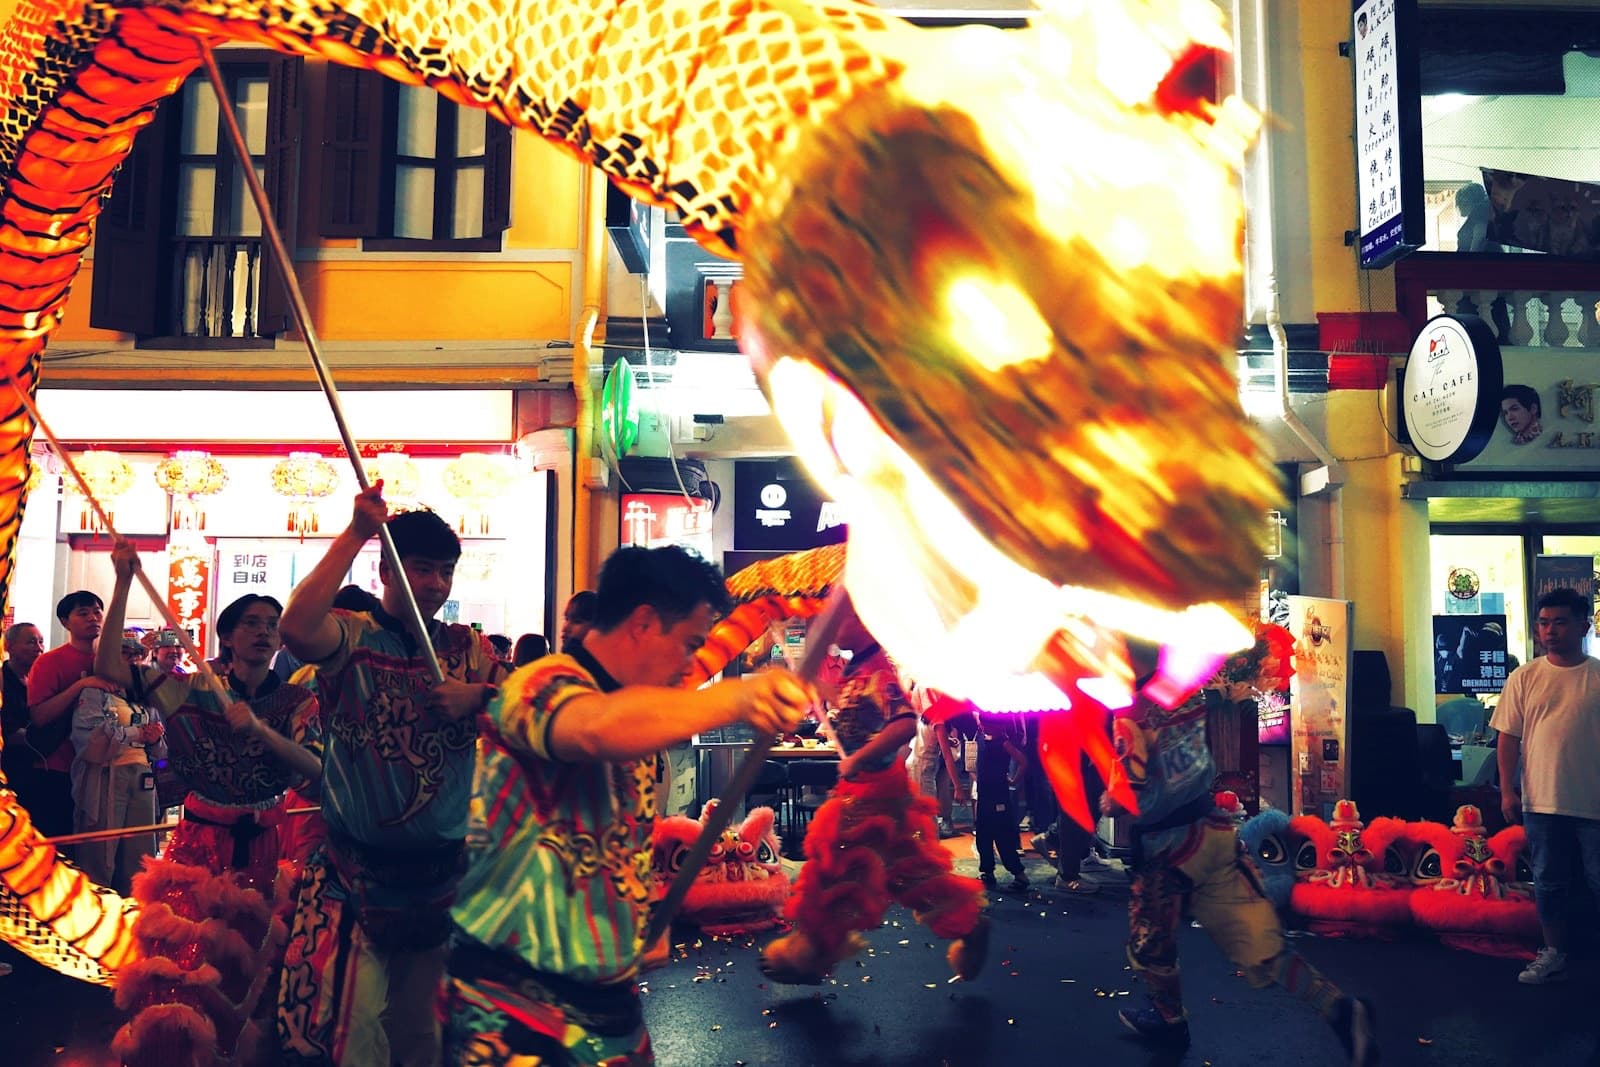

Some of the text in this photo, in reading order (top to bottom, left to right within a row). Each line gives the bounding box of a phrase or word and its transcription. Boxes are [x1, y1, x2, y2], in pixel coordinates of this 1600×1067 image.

[1413, 372, 1473, 403] CAT CAFE
[233, 554, 267, 568] 到店
[233, 571, 267, 584] 自取
[1461, 679, 1492, 688] GRENADE
